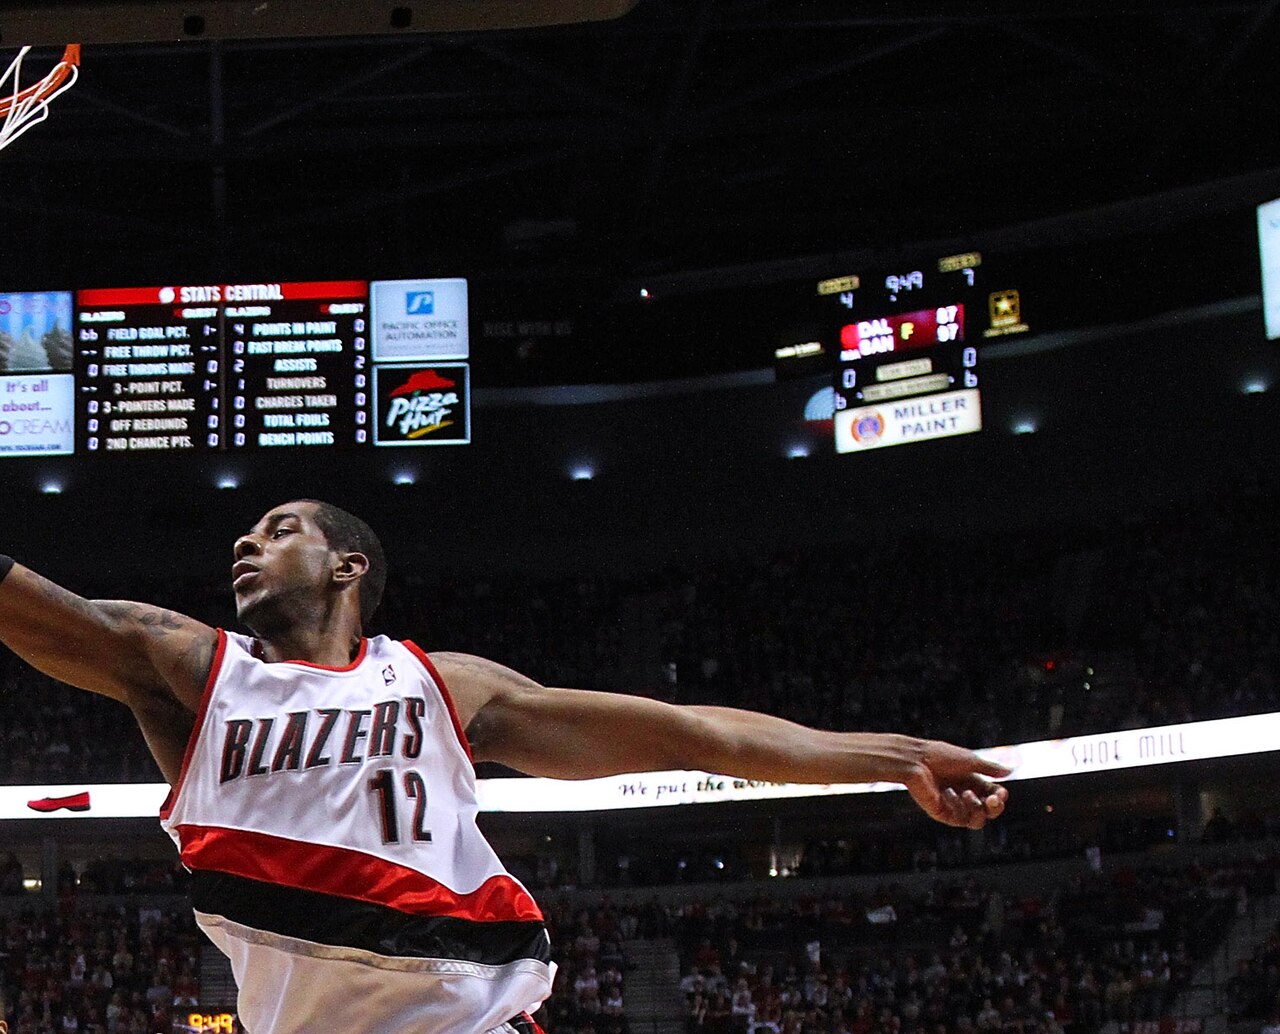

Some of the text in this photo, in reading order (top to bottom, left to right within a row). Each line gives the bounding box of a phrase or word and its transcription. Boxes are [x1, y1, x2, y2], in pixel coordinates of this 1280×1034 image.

[180, 284, 284, 303] STATS CENTRAL
[253, 323, 291, 336] POINTS
[306, 322, 337, 334] PAINT
[382, 321, 419, 330] PACIFIC
[107, 328, 138, 340] FIELD
[138, 327, 166, 340] GOAL
[386, 330, 457, 341] AUTOMATION
[104, 346, 131, 358] FREE
[132, 345, 168, 357] THROW
[247, 341, 273, 354] FAST
[306, 339, 342, 352] POINTS
[102, 363, 128, 376] FREE
[274, 358, 317, 371] ASSISTS
[32, 380, 48, 393] all
[161, 381, 185, 393] PCT.
[266, 376, 326, 390] TURNOVERS
[255, 396, 303, 409] CHARGES
[304, 395, 337, 407] TAKEN
[895, 398, 966, 419] MILLER
[386, 393, 459, 427] Pizza
[110, 419, 132, 431] OFF
[133, 418, 188, 430] REBOUNDS
[264, 414, 295, 427] TOTAL
[296, 413, 330, 426] FOULS
[399, 408, 453, 434] Hut
[902, 416, 957, 436] PAINT
[106, 438, 127, 450] 2ND
[128, 437, 170, 449] CHANCE
[258, 433, 295, 446] BENCH
[296, 432, 334, 444] POINTS
[220, 696, 426, 785] BLAZERS
[619, 782, 647, 796] We
[656, 782, 687, 800] put
[697, 776, 725, 792] the
[368, 769, 432, 846] 12
[189, 1013, 233, 1034] 9:49
